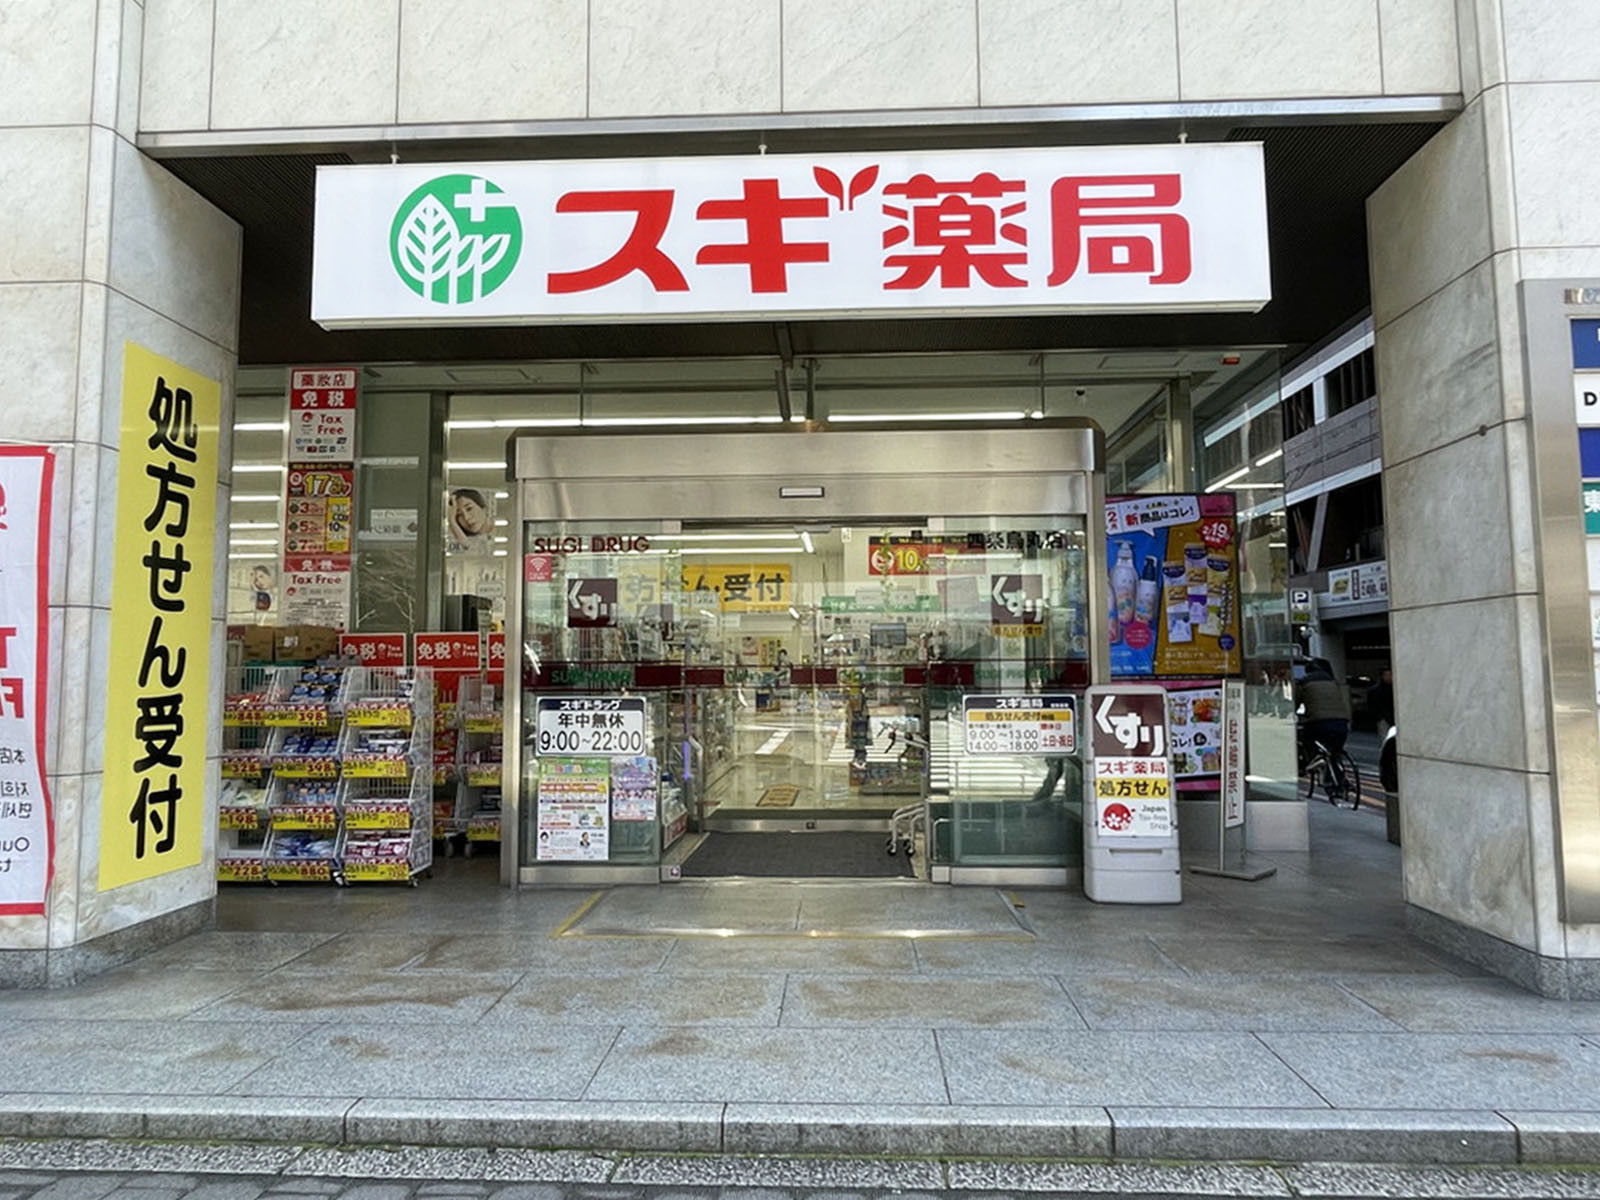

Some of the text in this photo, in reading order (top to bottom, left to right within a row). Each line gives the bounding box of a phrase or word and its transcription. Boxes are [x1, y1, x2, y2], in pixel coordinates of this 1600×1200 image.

[547, 164, 1192, 295] スギ薬局
[320, 414, 342, 424] Tax
[317, 424, 345, 435] Free
[534, 536, 650, 553] SUGI DRUG
[291, 574, 342, 584] Tax Free
[568, 580, 617, 626] くすり
[992, 577, 1042, 622] くすり
[129, 376, 200, 860] 処方せん受付
[418, 643, 451, 660] 免税
[560, 701, 620, 710] スギドラッグ
[558, 713, 625, 729] 年中無休
[1096, 695, 1165, 756] くすり
[1098, 760, 1166, 775] スギ薬局
[1099, 780, 1167, 796] 処方せん
